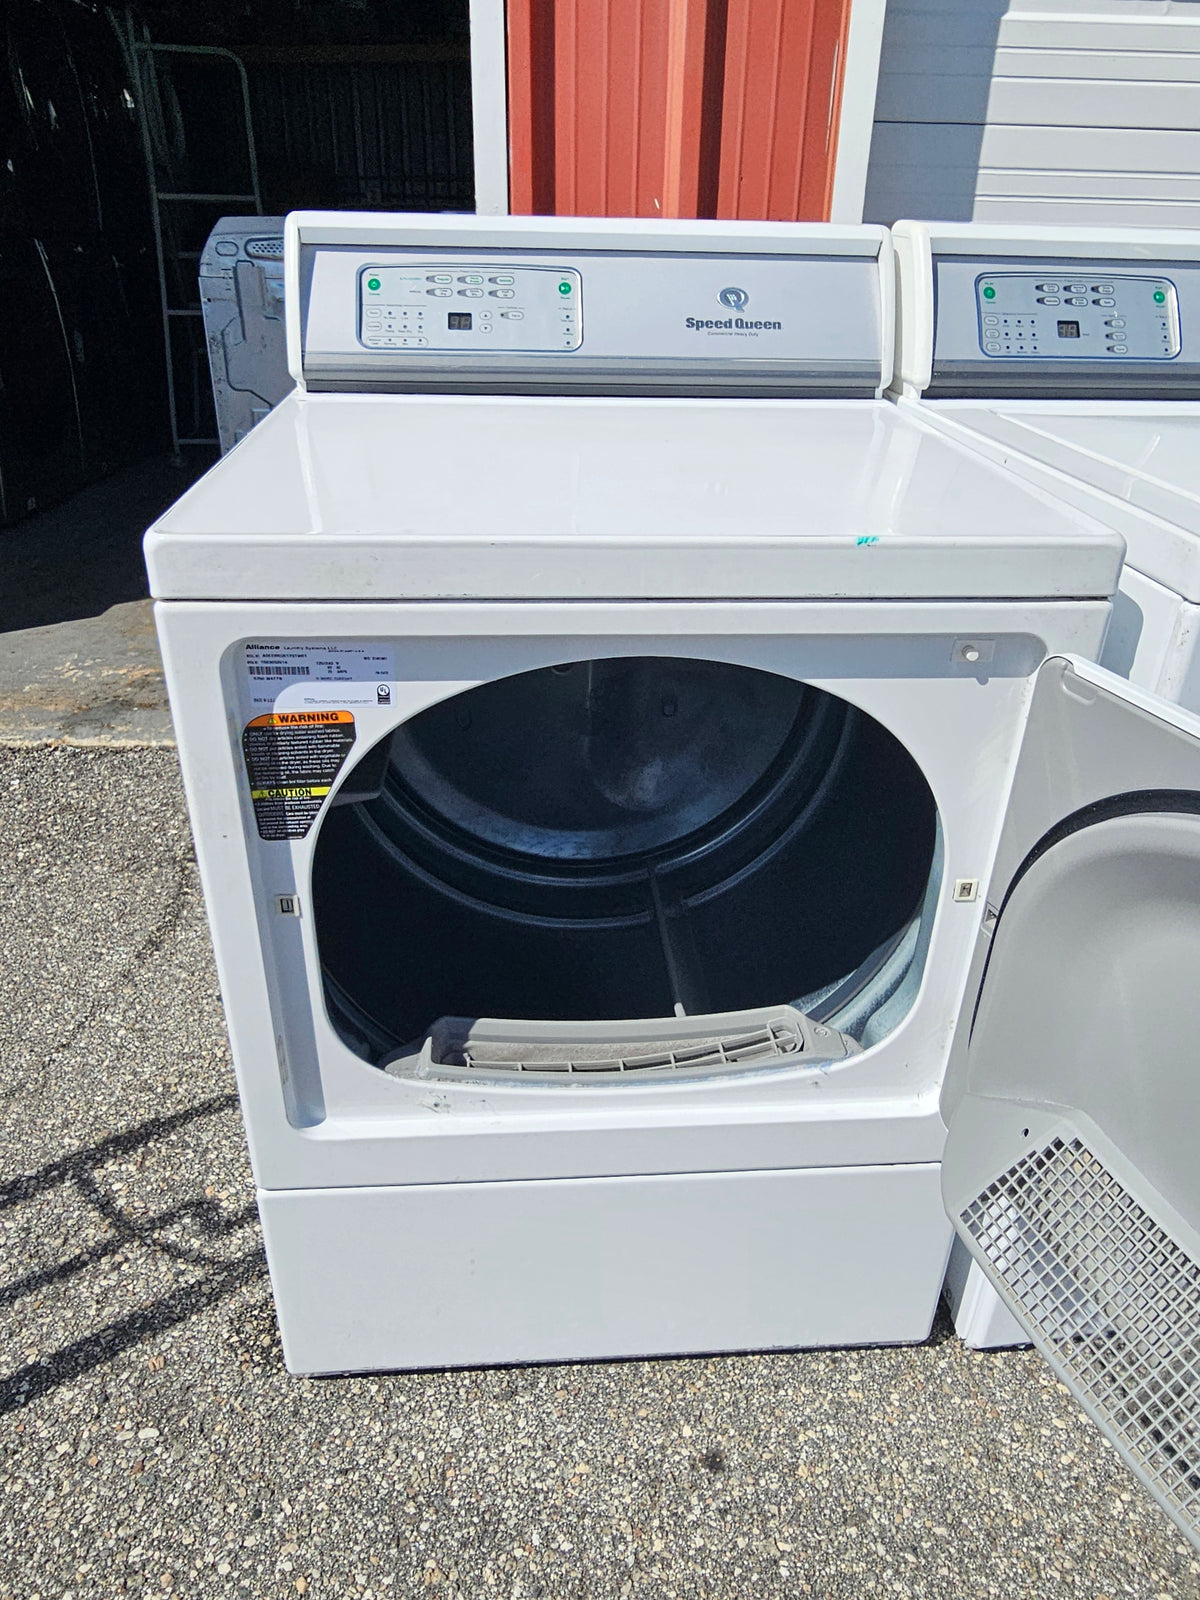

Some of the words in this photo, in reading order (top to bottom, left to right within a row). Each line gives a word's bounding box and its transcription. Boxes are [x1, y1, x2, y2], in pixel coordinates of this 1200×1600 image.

[685, 317, 733, 331] Speed
[735, 317, 782, 330] Queen
[278, 713, 339, 723] WARNING
[267, 788, 312, 798] CAUTION
